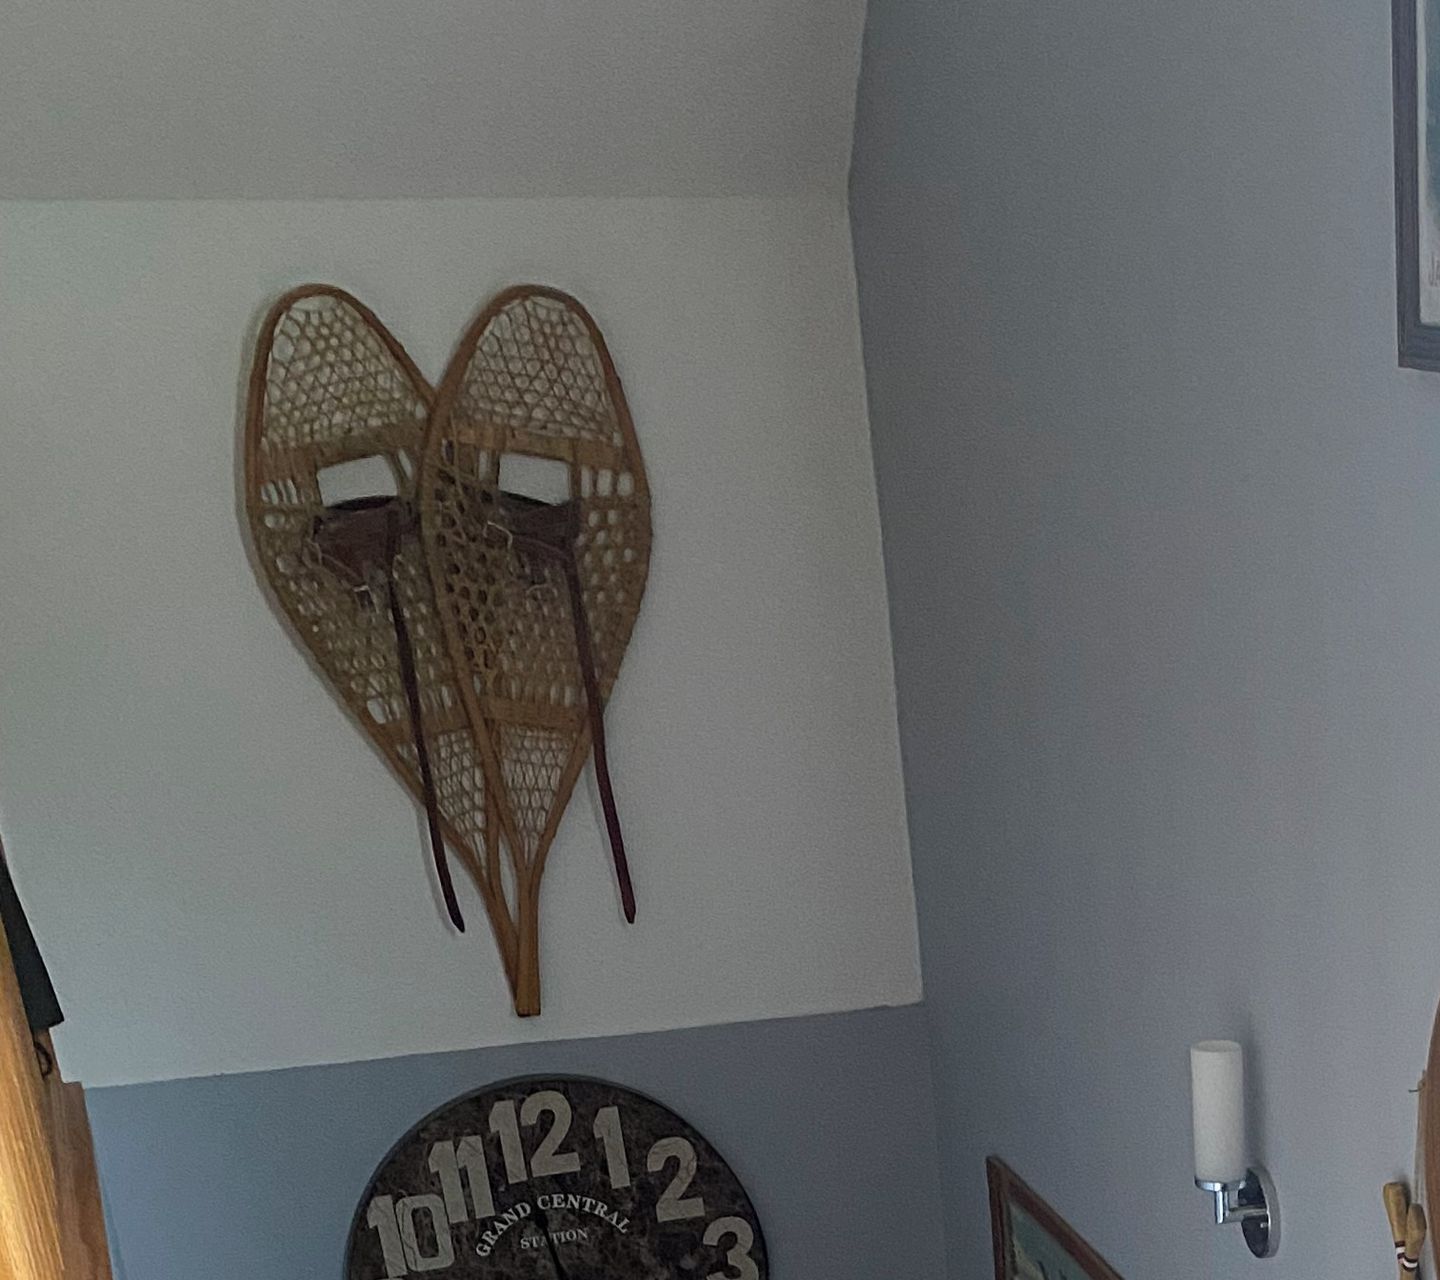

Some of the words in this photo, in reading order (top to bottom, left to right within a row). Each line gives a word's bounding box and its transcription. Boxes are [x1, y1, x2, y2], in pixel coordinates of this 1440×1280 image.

[428, 1135, 496, 1224] 11
[489, 1090, 581, 1185] 12
[593, 1105, 631, 1190] 1
[647, 1136, 705, 1223] 2
[366, 1193, 455, 1278] 10
[475, 1201, 532, 1258] GRAND
[536, 1193, 632, 1235] CENTRAL
[520, 1228, 588, 1250] STATION
